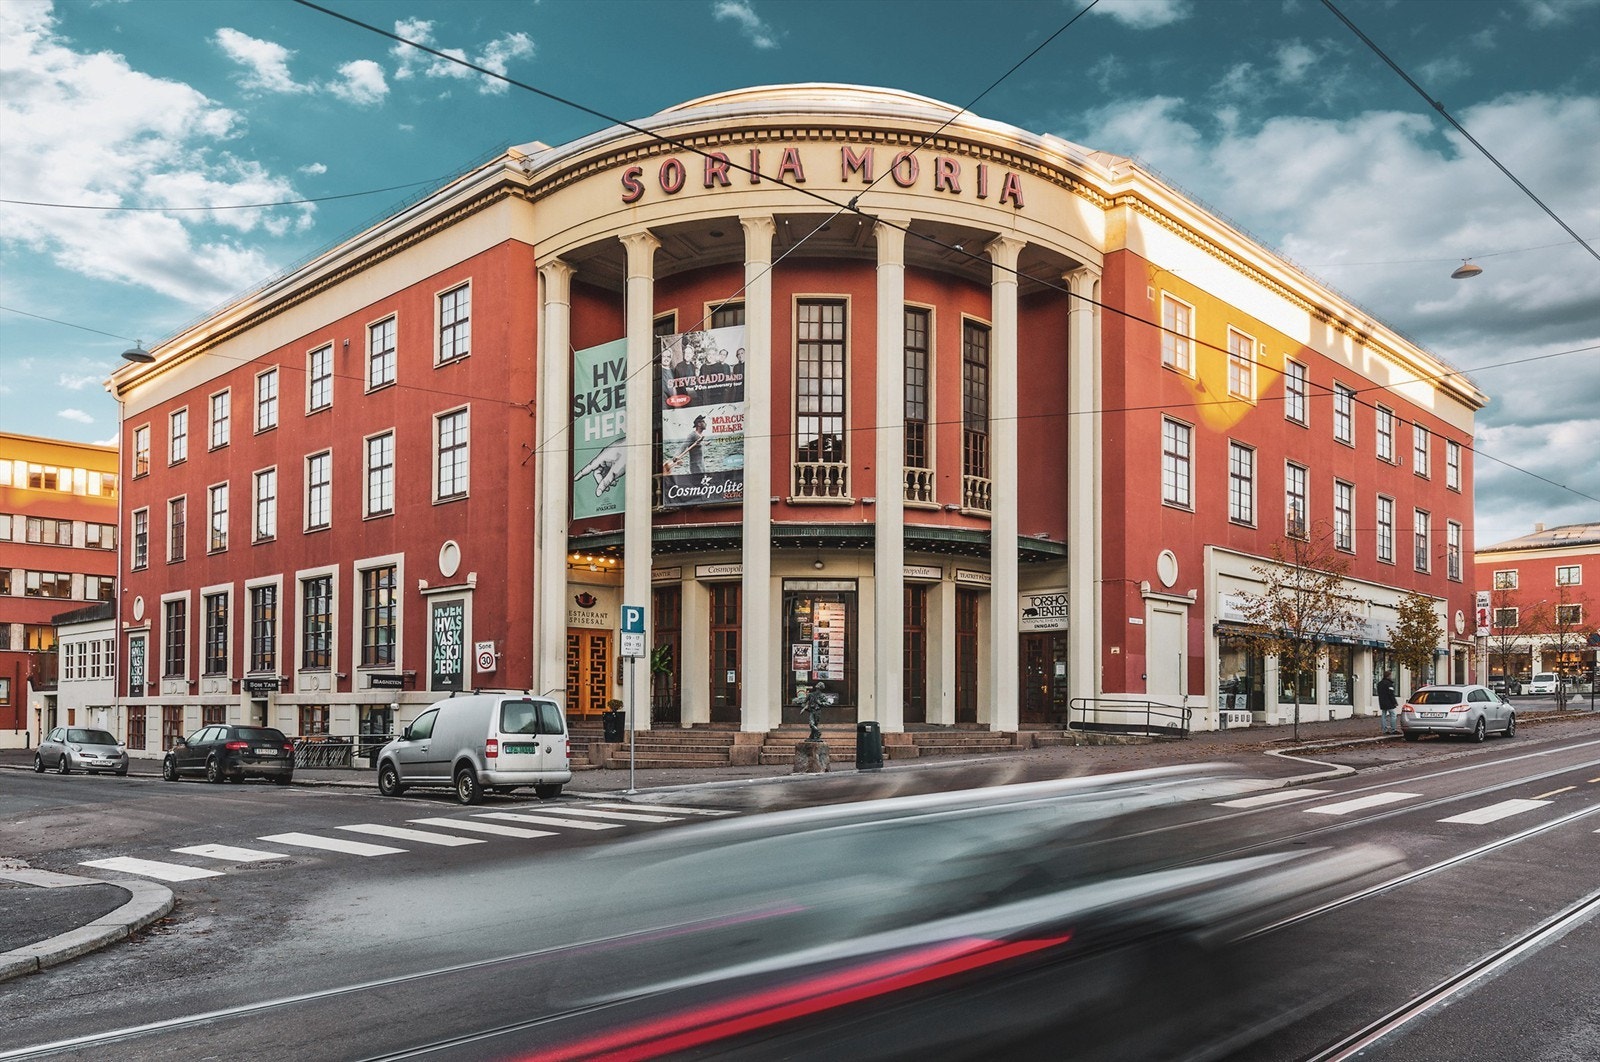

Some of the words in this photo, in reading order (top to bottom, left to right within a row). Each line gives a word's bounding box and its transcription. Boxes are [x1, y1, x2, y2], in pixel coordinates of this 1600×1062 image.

[622, 146, 806, 204] SORIA
[841, 145, 1025, 209] MORIA
[667, 376, 696, 388] STEVE
[697, 373, 725, 385] GADD
[725, 373, 743, 382] BAND
[712, 423, 743, 433] MILLER
[668, 479, 743, 498] Cosmopolite
[627, 609, 639, 630] P
[481, 656, 491, 665] 30
